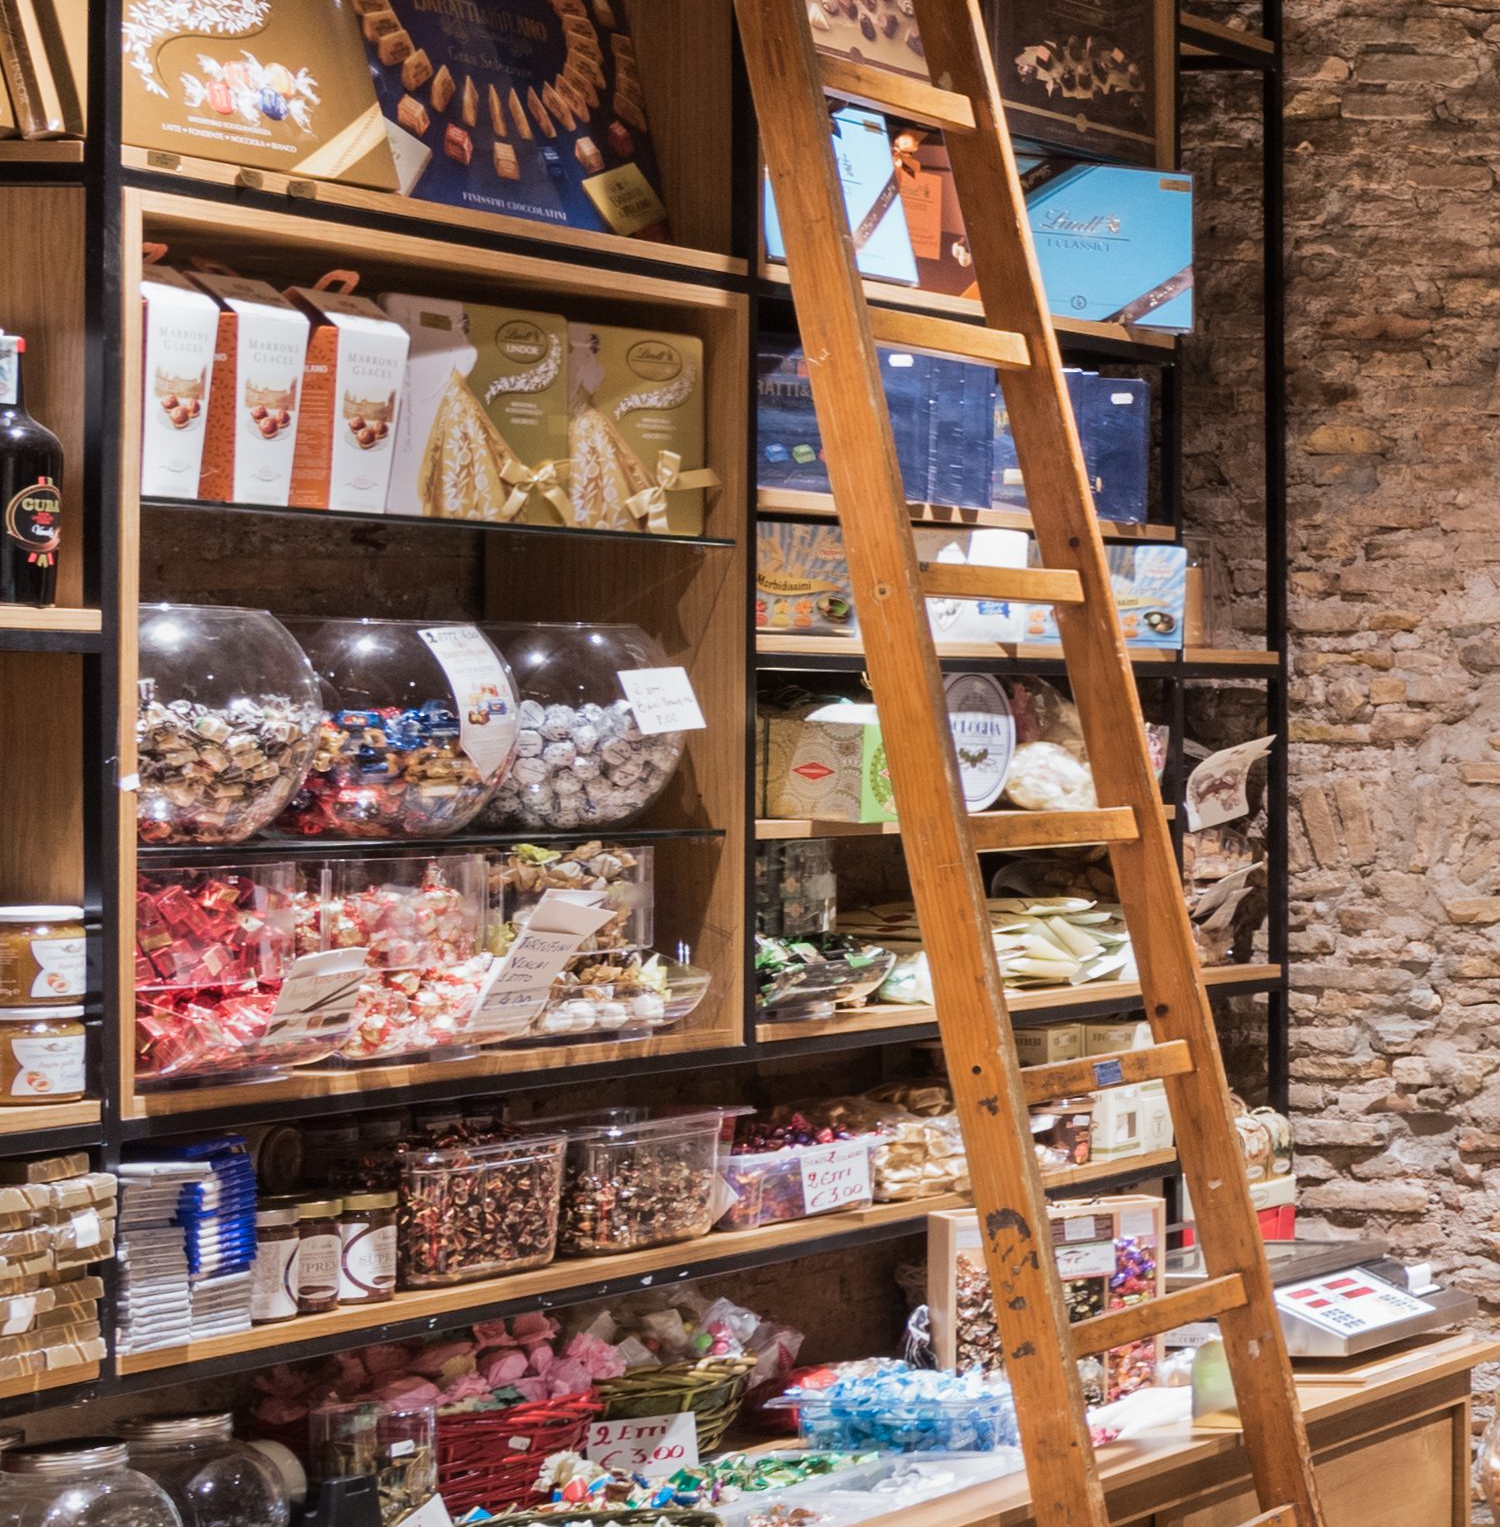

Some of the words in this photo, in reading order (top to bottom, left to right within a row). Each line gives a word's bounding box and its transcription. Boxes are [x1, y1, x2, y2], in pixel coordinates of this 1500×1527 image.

[461, 190, 505, 209] FINISSIMI
[1039, 209, 1105, 233] Lindt
[1055, 239, 1110, 253] CLASSICI
[249, 339, 300, 356] MARRONS
[506, 344, 539, 356] LINDOR
[347, 352, 399, 368] MARRONS
[806, 1173, 819, 1189] 2
[810, 1191, 827, 1209] €
[592, 1425, 609, 1447] 2
[600, 1450, 623, 1470] €
